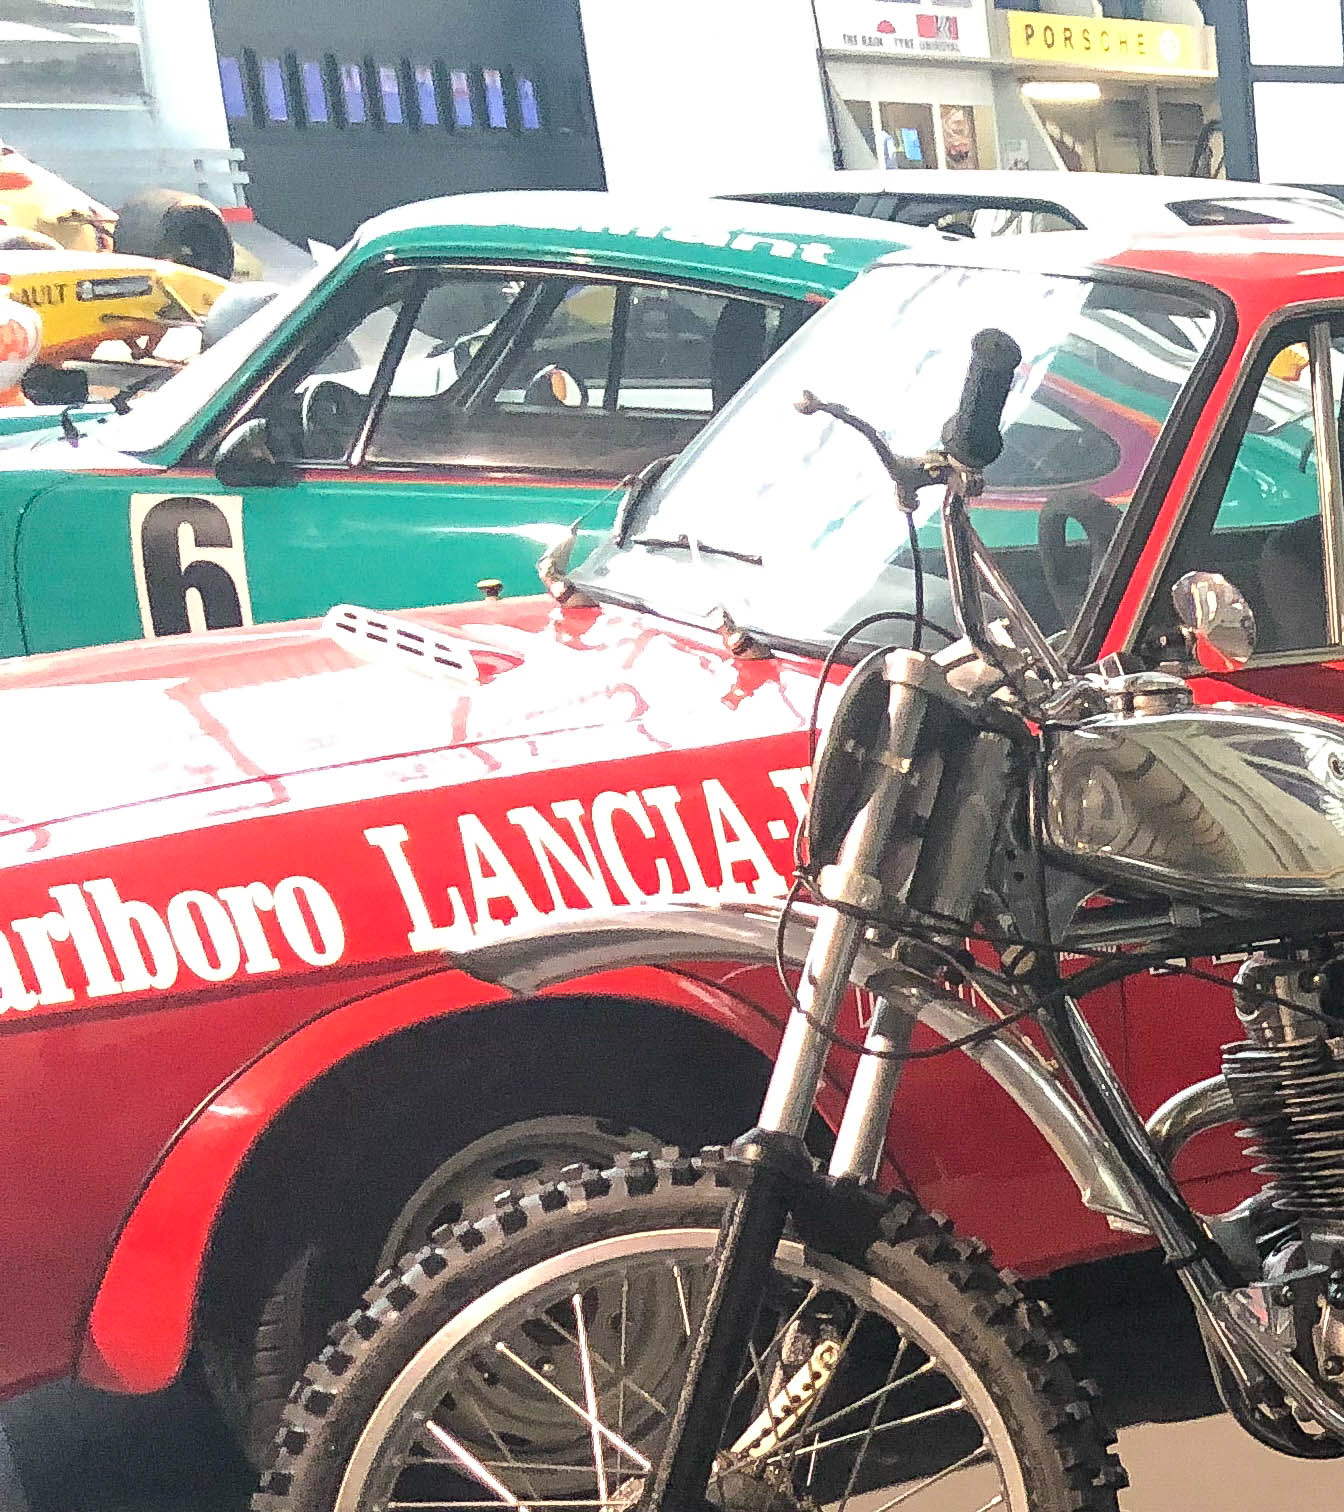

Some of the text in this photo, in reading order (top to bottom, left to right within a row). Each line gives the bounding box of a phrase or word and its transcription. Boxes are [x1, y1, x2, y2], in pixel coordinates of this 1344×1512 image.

[1024, 23, 1147, 55] PORSCHE
[10, 284, 66, 307] AULT
[141, 497, 243, 637] 6
